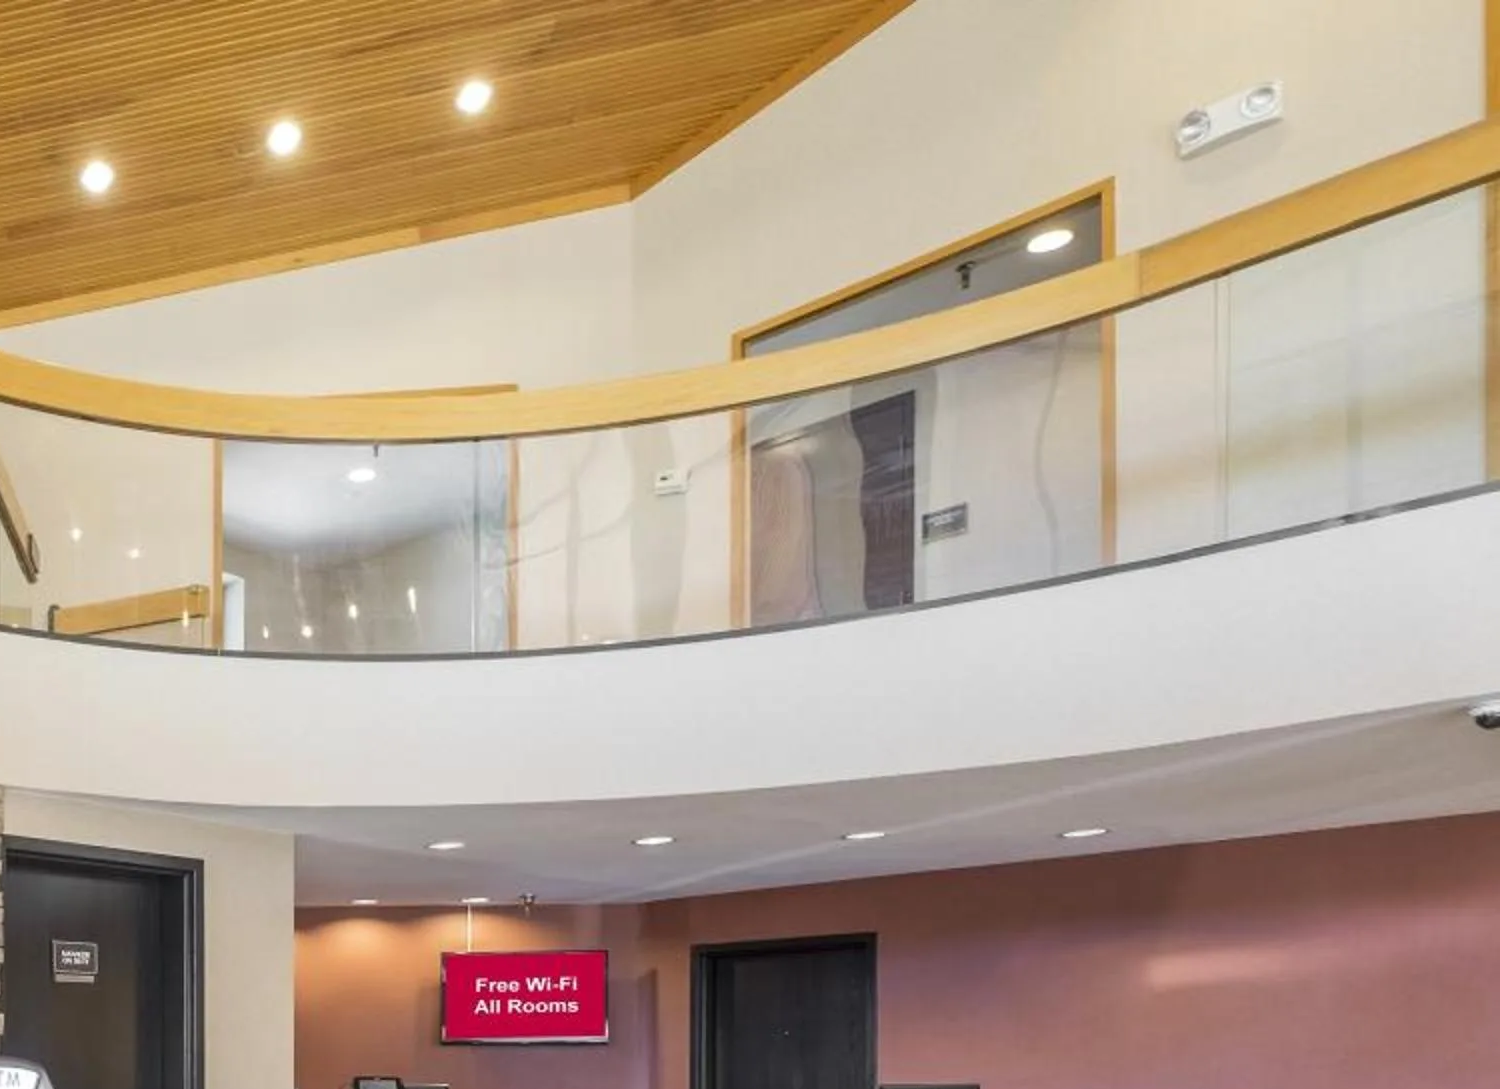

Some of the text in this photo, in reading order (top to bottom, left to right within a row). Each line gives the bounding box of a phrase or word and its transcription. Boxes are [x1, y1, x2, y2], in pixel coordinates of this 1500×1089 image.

[475, 976, 578, 993] Free Wi-Fi
[474, 999, 579, 1015] All Rooms
